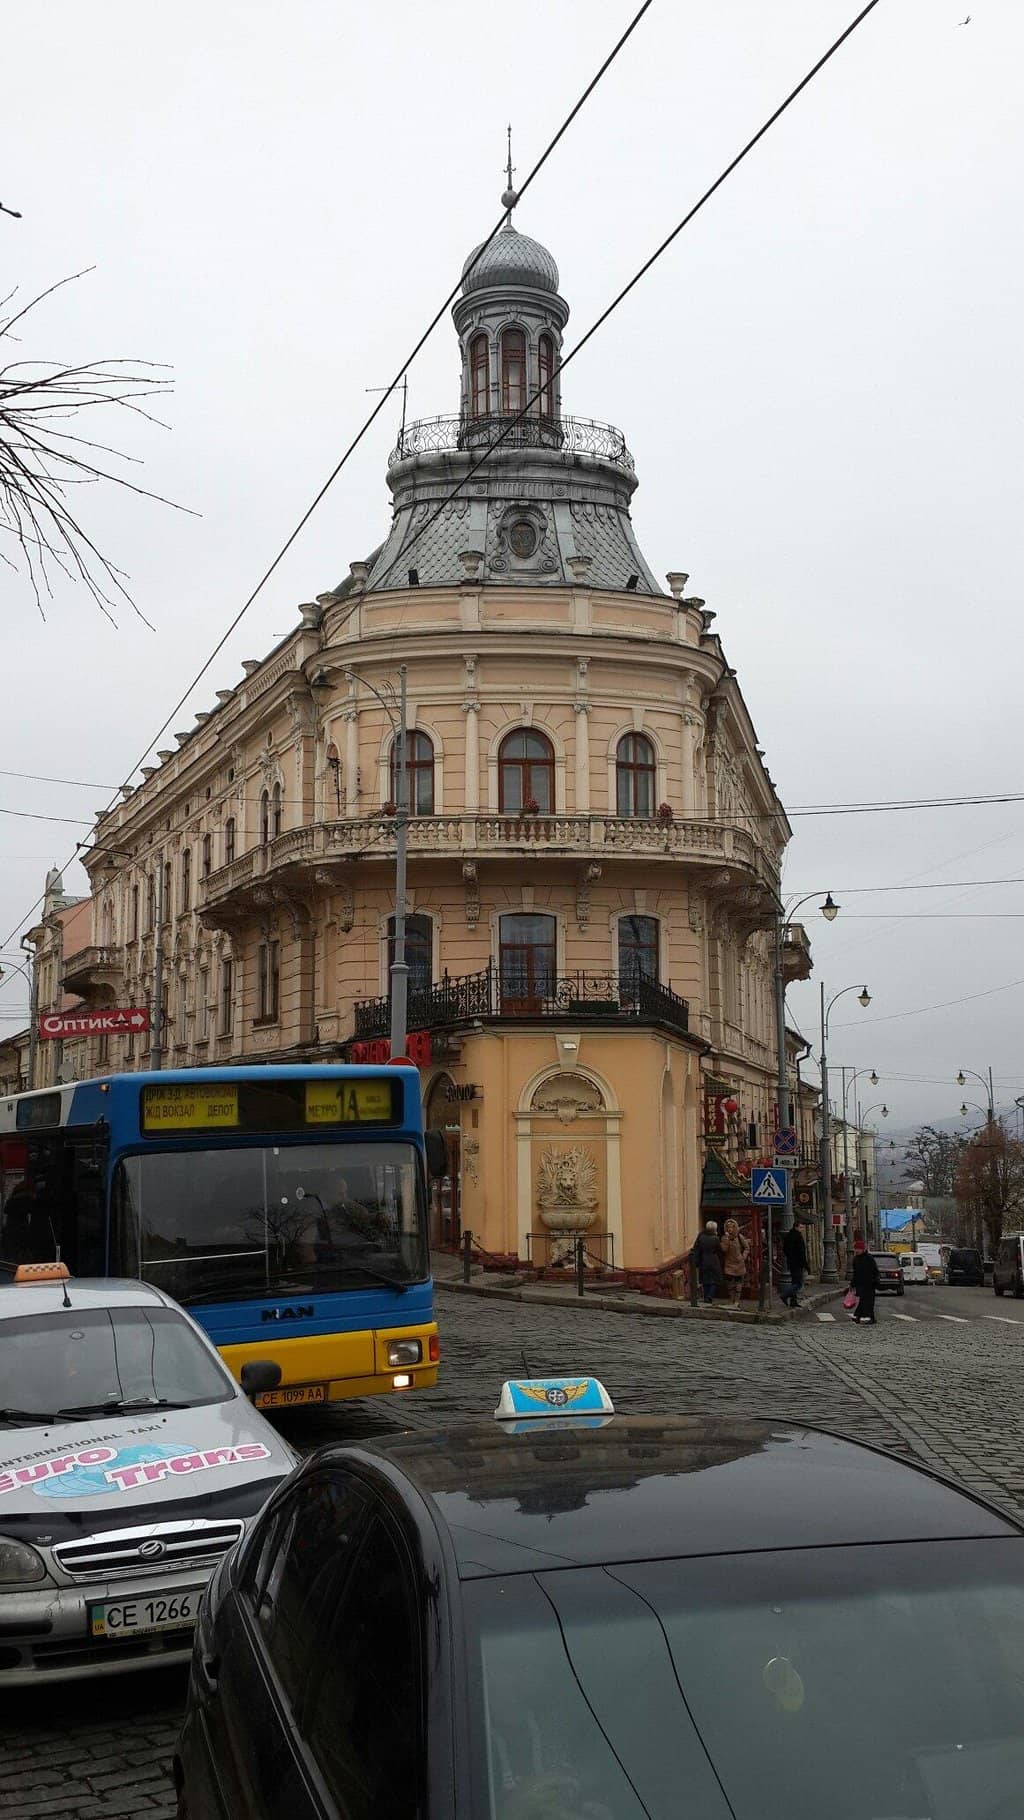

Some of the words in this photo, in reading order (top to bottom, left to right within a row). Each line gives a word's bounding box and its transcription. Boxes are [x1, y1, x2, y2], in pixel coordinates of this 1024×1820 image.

[261, 1305, 315, 1322] MAN
[280, 1389, 305, 1402] 1099
[127, 1424, 162, 1436] TAXI
[110, 1444, 269, 1488] Trans
[145, 1596, 191, 1623] 1266
